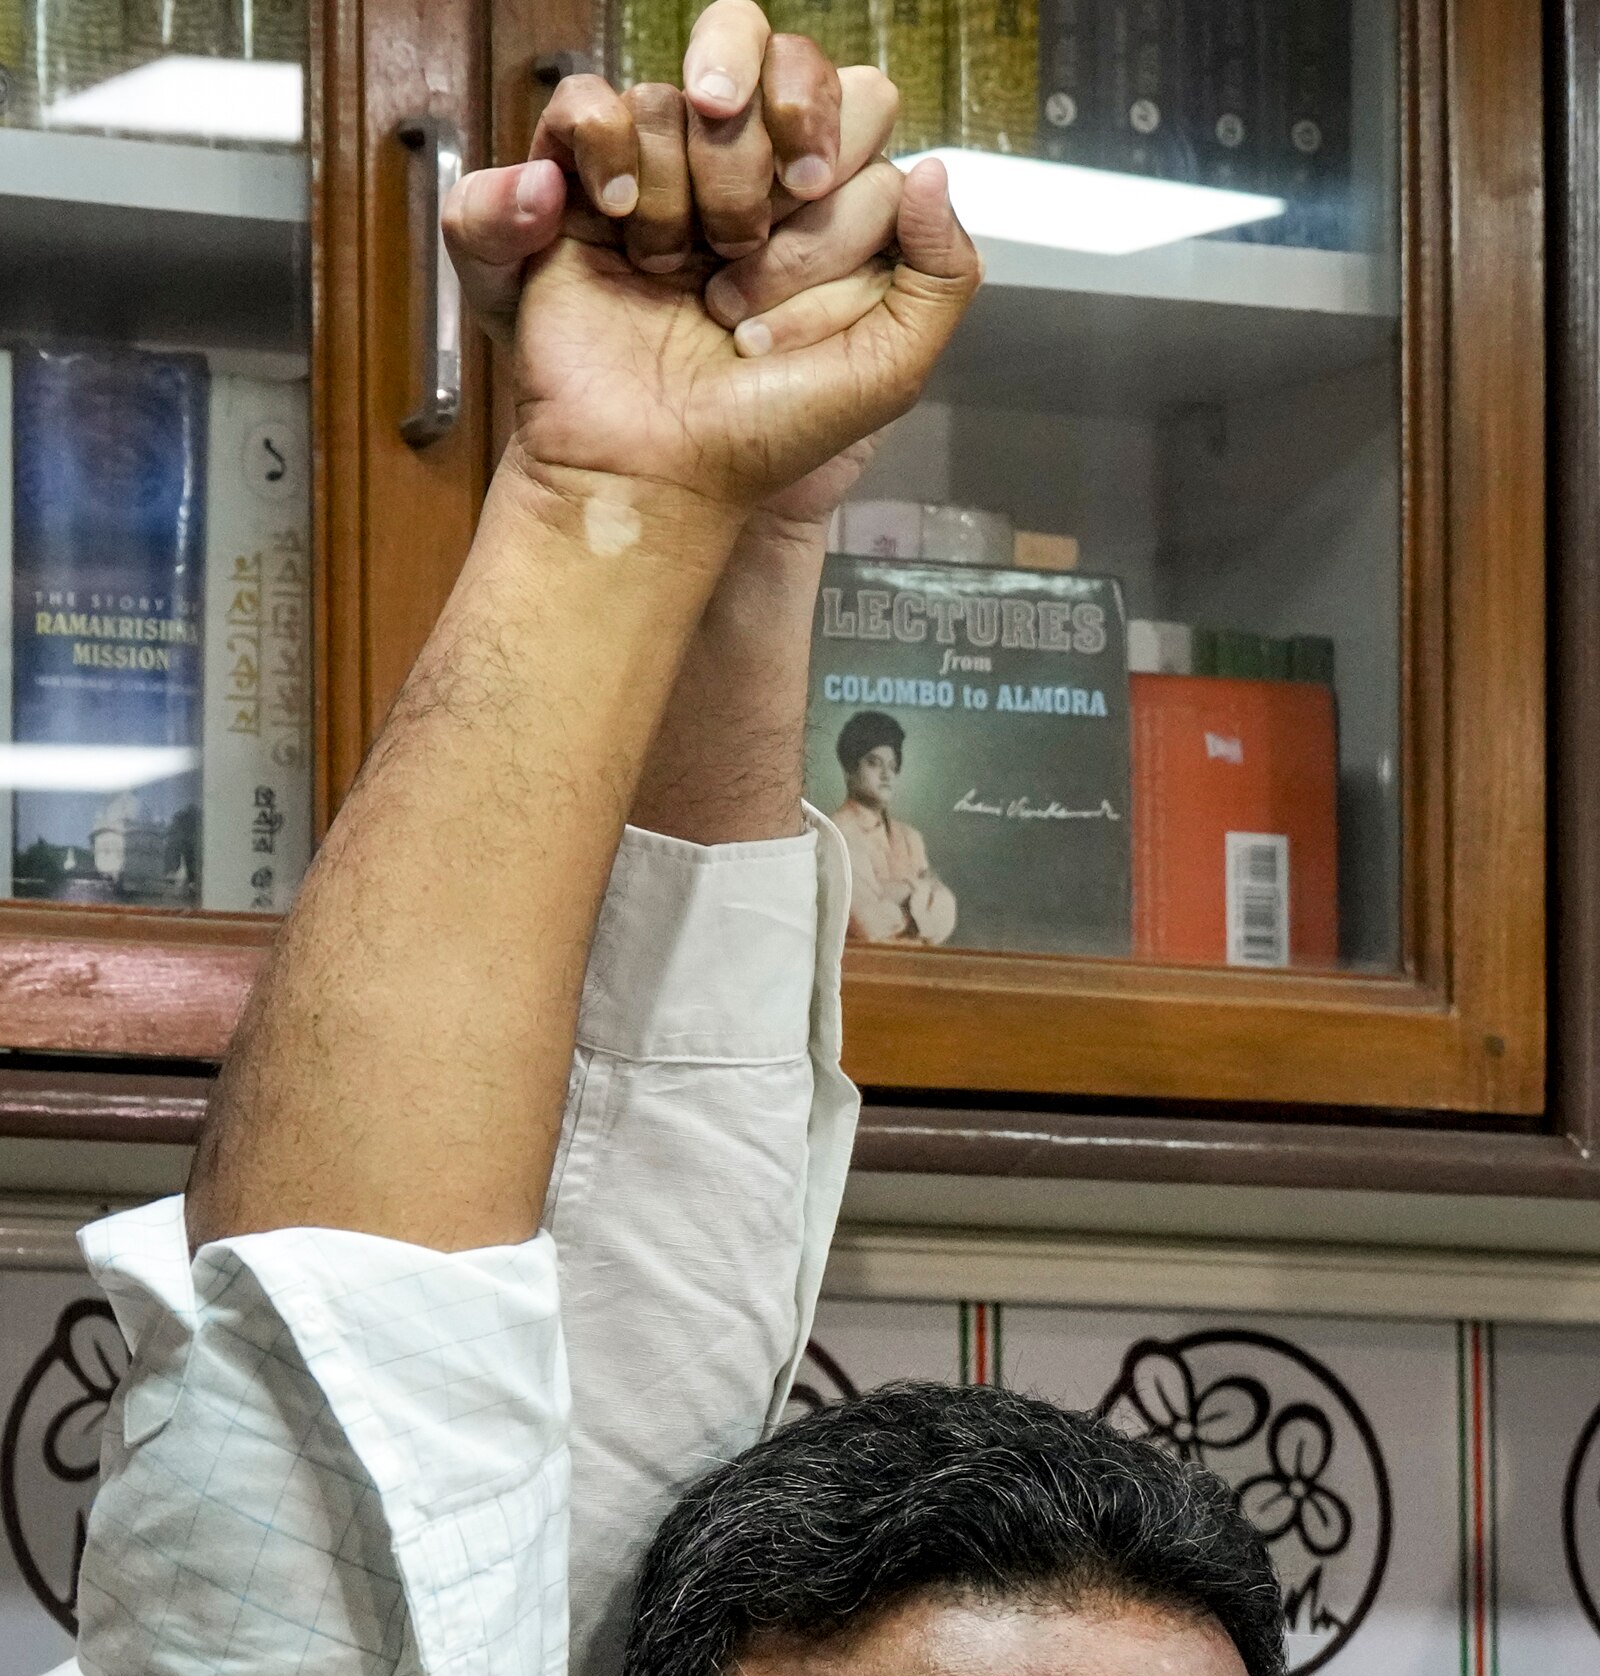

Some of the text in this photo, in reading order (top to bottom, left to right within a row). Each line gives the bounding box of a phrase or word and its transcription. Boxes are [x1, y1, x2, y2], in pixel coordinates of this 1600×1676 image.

[35, 612, 198, 643] RAMAKRISHNA
[822, 587, 1106, 653] LECTURES
[72, 642, 171, 671] MISSION
[939, 649, 993, 676] from
[823, 674, 1108, 717] COLOMBO to ALMORA
